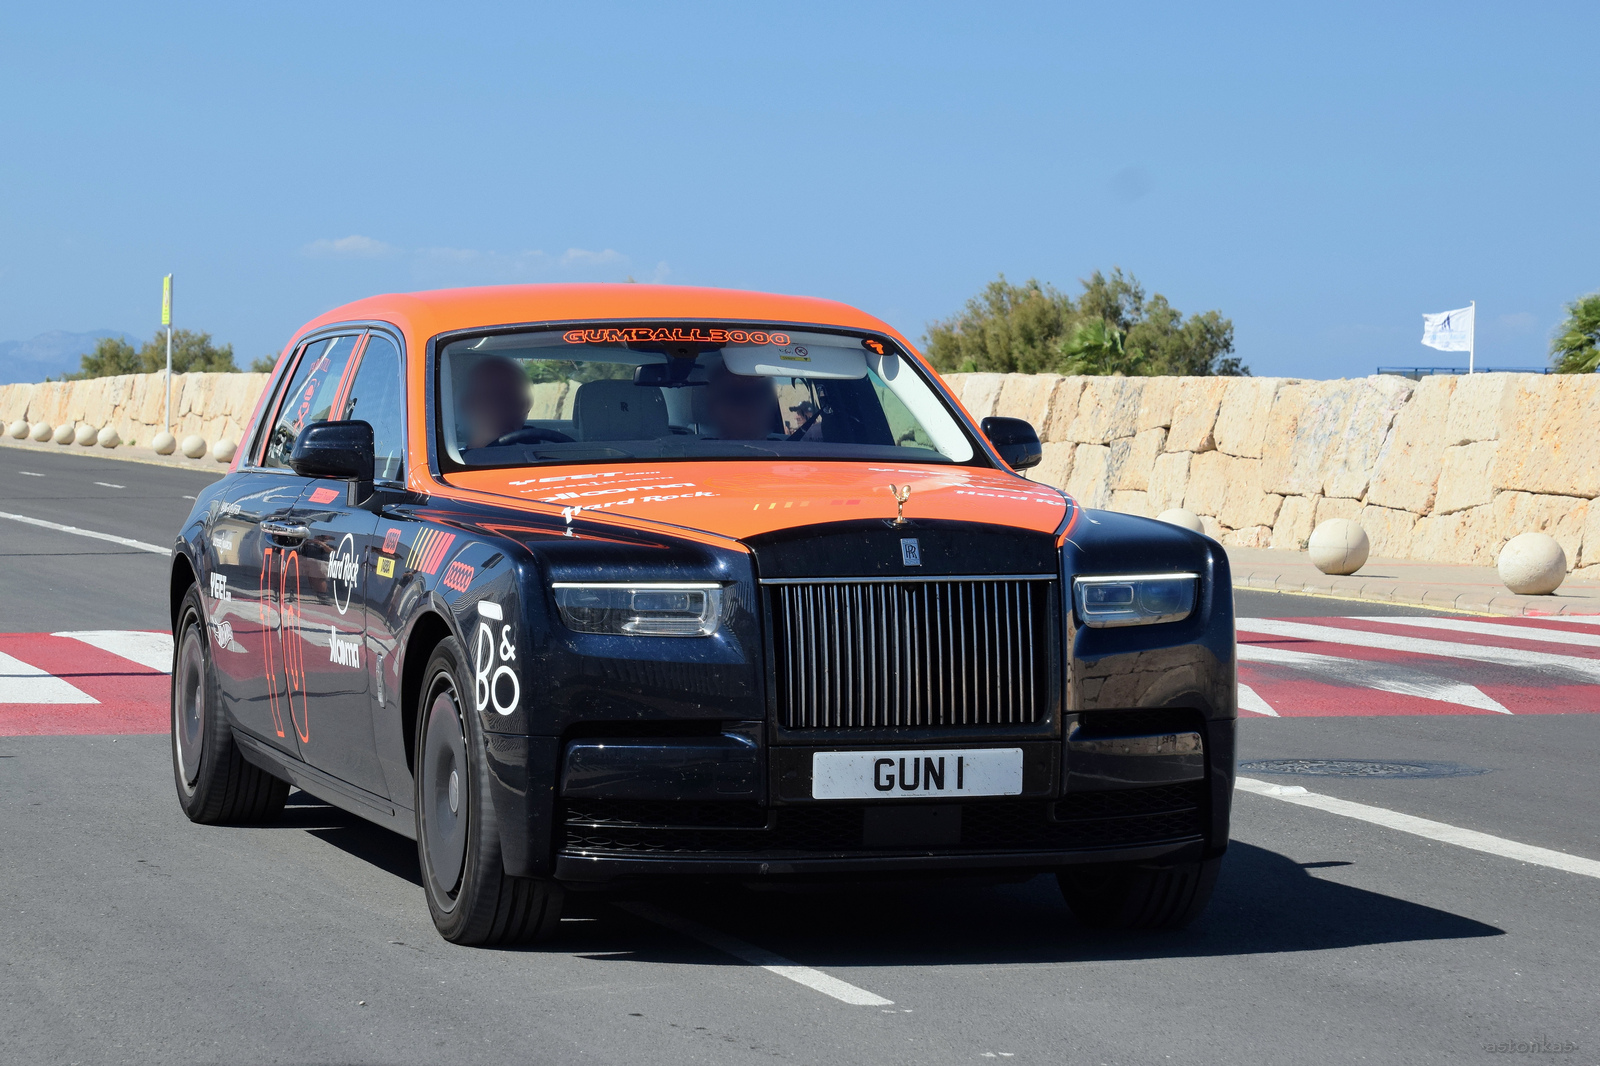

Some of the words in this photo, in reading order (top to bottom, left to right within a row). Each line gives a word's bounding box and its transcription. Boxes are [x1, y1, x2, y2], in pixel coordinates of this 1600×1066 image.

[563, 327, 791, 346] GUMBALL3000
[642, 491, 713, 502] Rock
[475, 621, 521, 716] B&O
[873, 756, 945, 792] GUN
